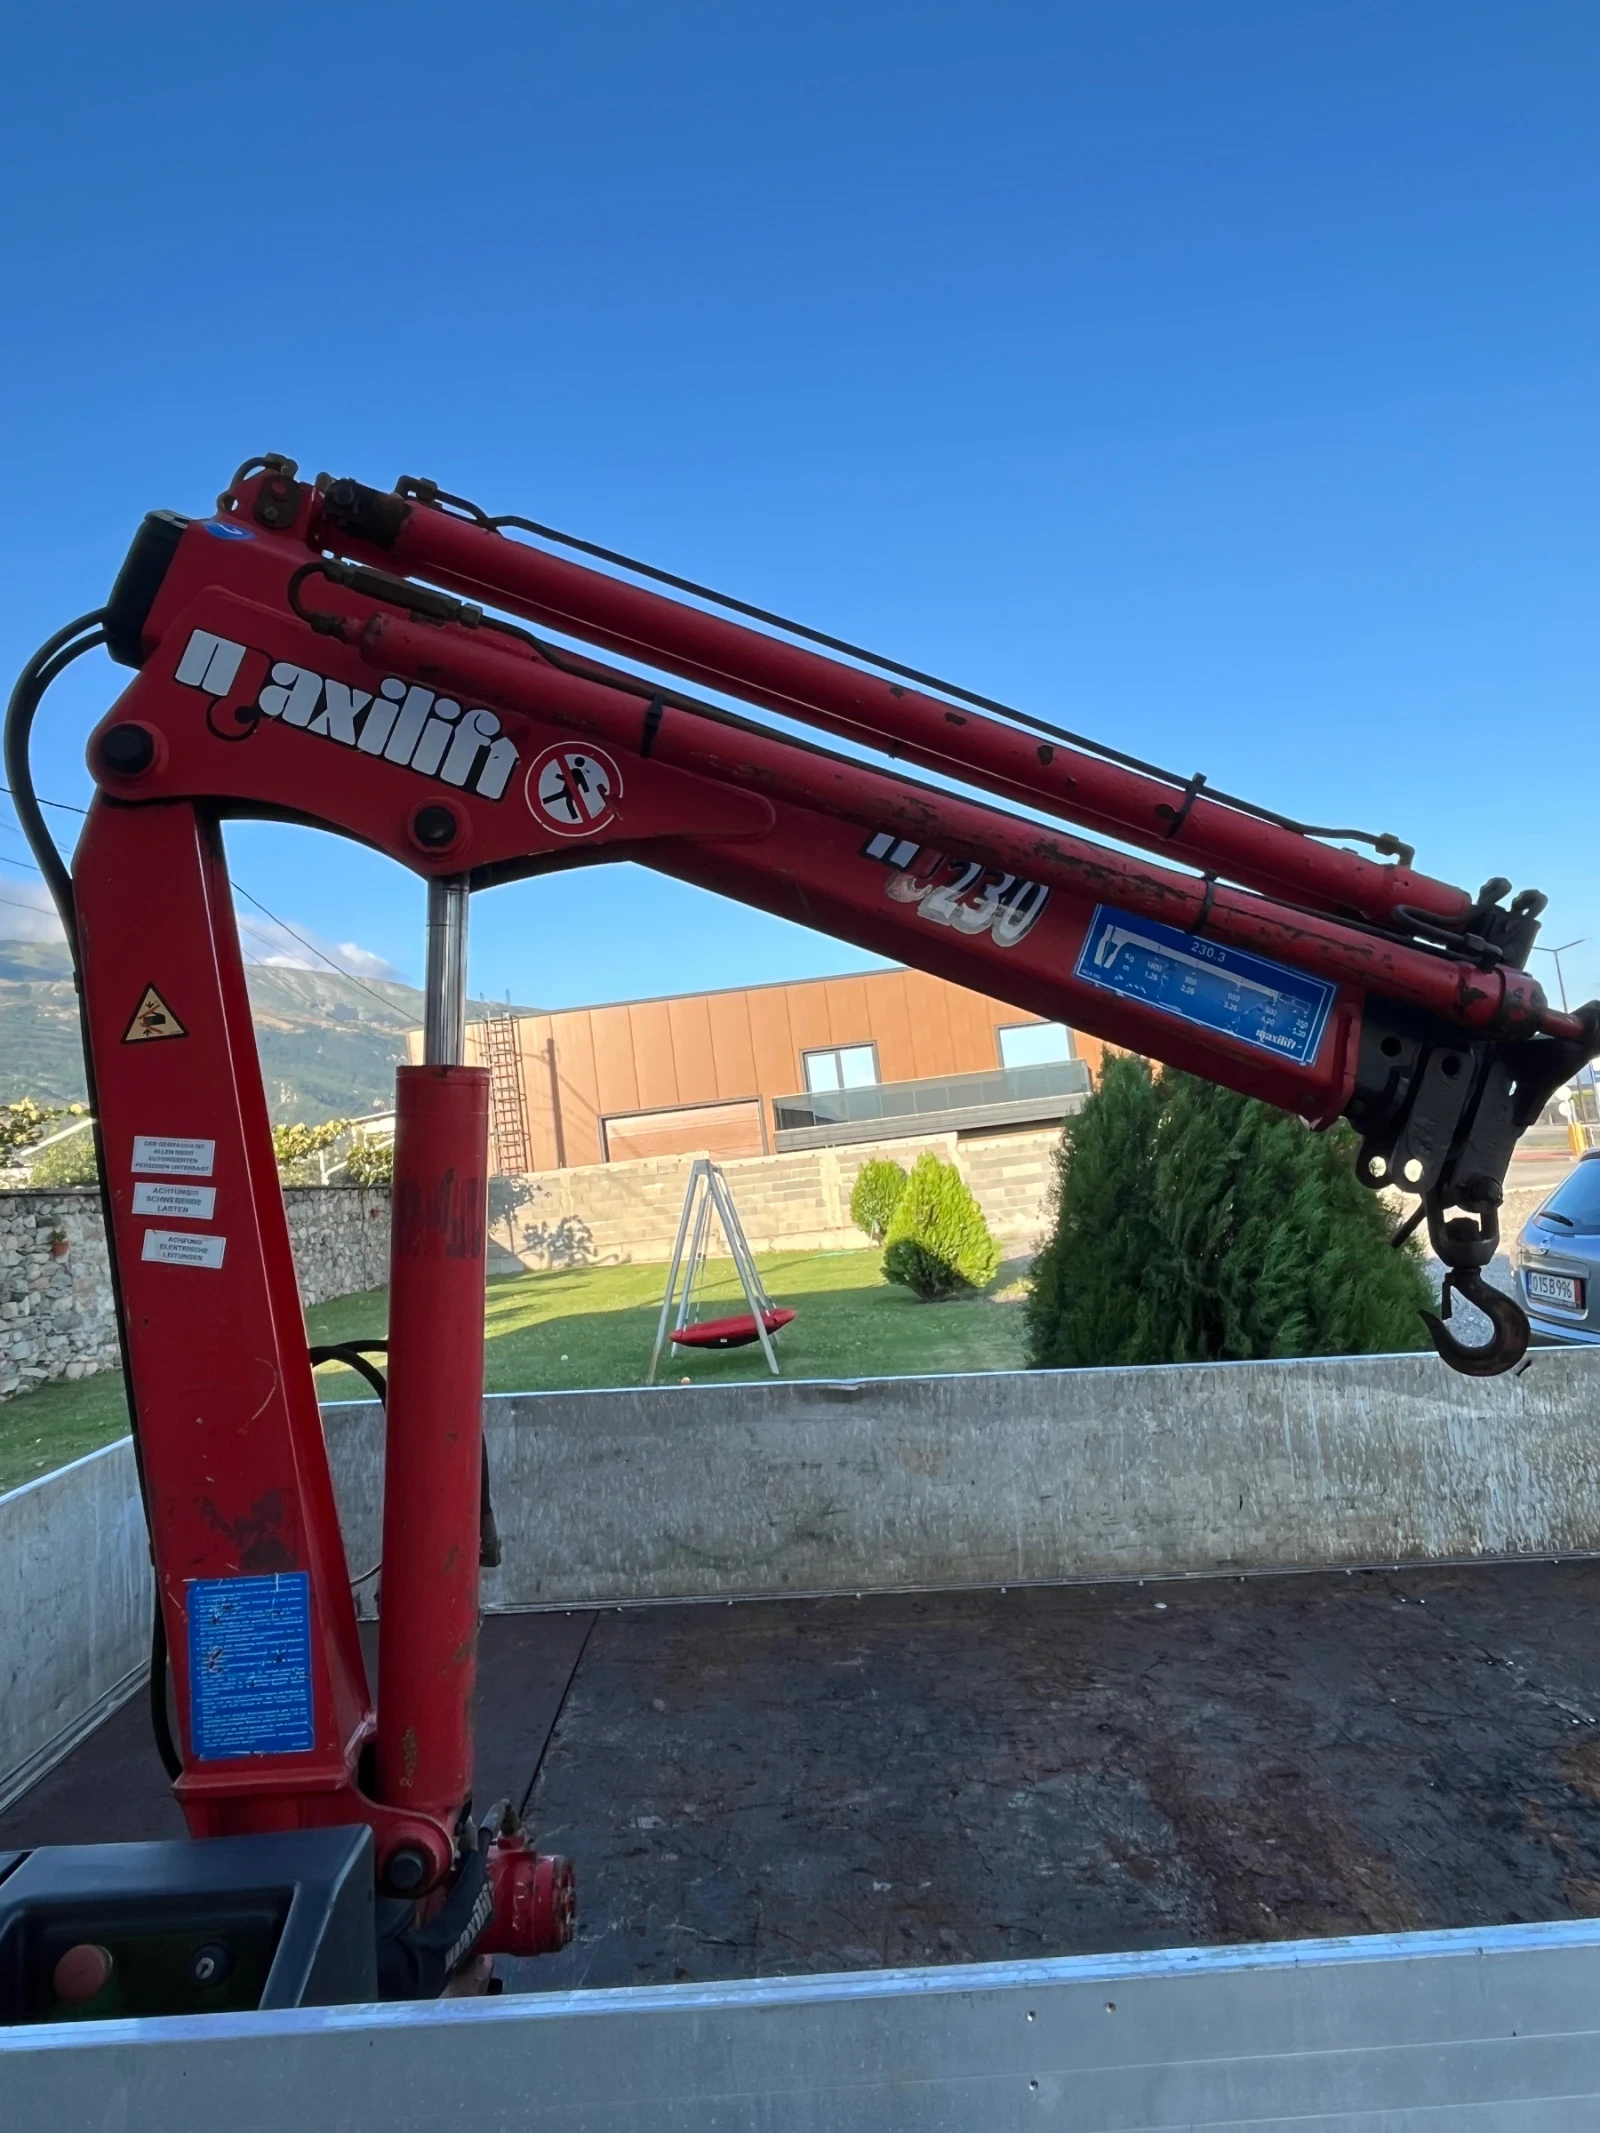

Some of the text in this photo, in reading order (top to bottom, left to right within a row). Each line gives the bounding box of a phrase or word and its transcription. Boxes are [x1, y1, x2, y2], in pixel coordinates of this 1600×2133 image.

[1191, 941, 1226, 963] 230.3
[157, 1205, 189, 1213] LASTEN
[168, 1236, 203, 1245] ACHTUNG
[160, 1243, 208, 1254] ELEKTRISCHE
[162, 1251, 204, 1262] LEITUNGEN
